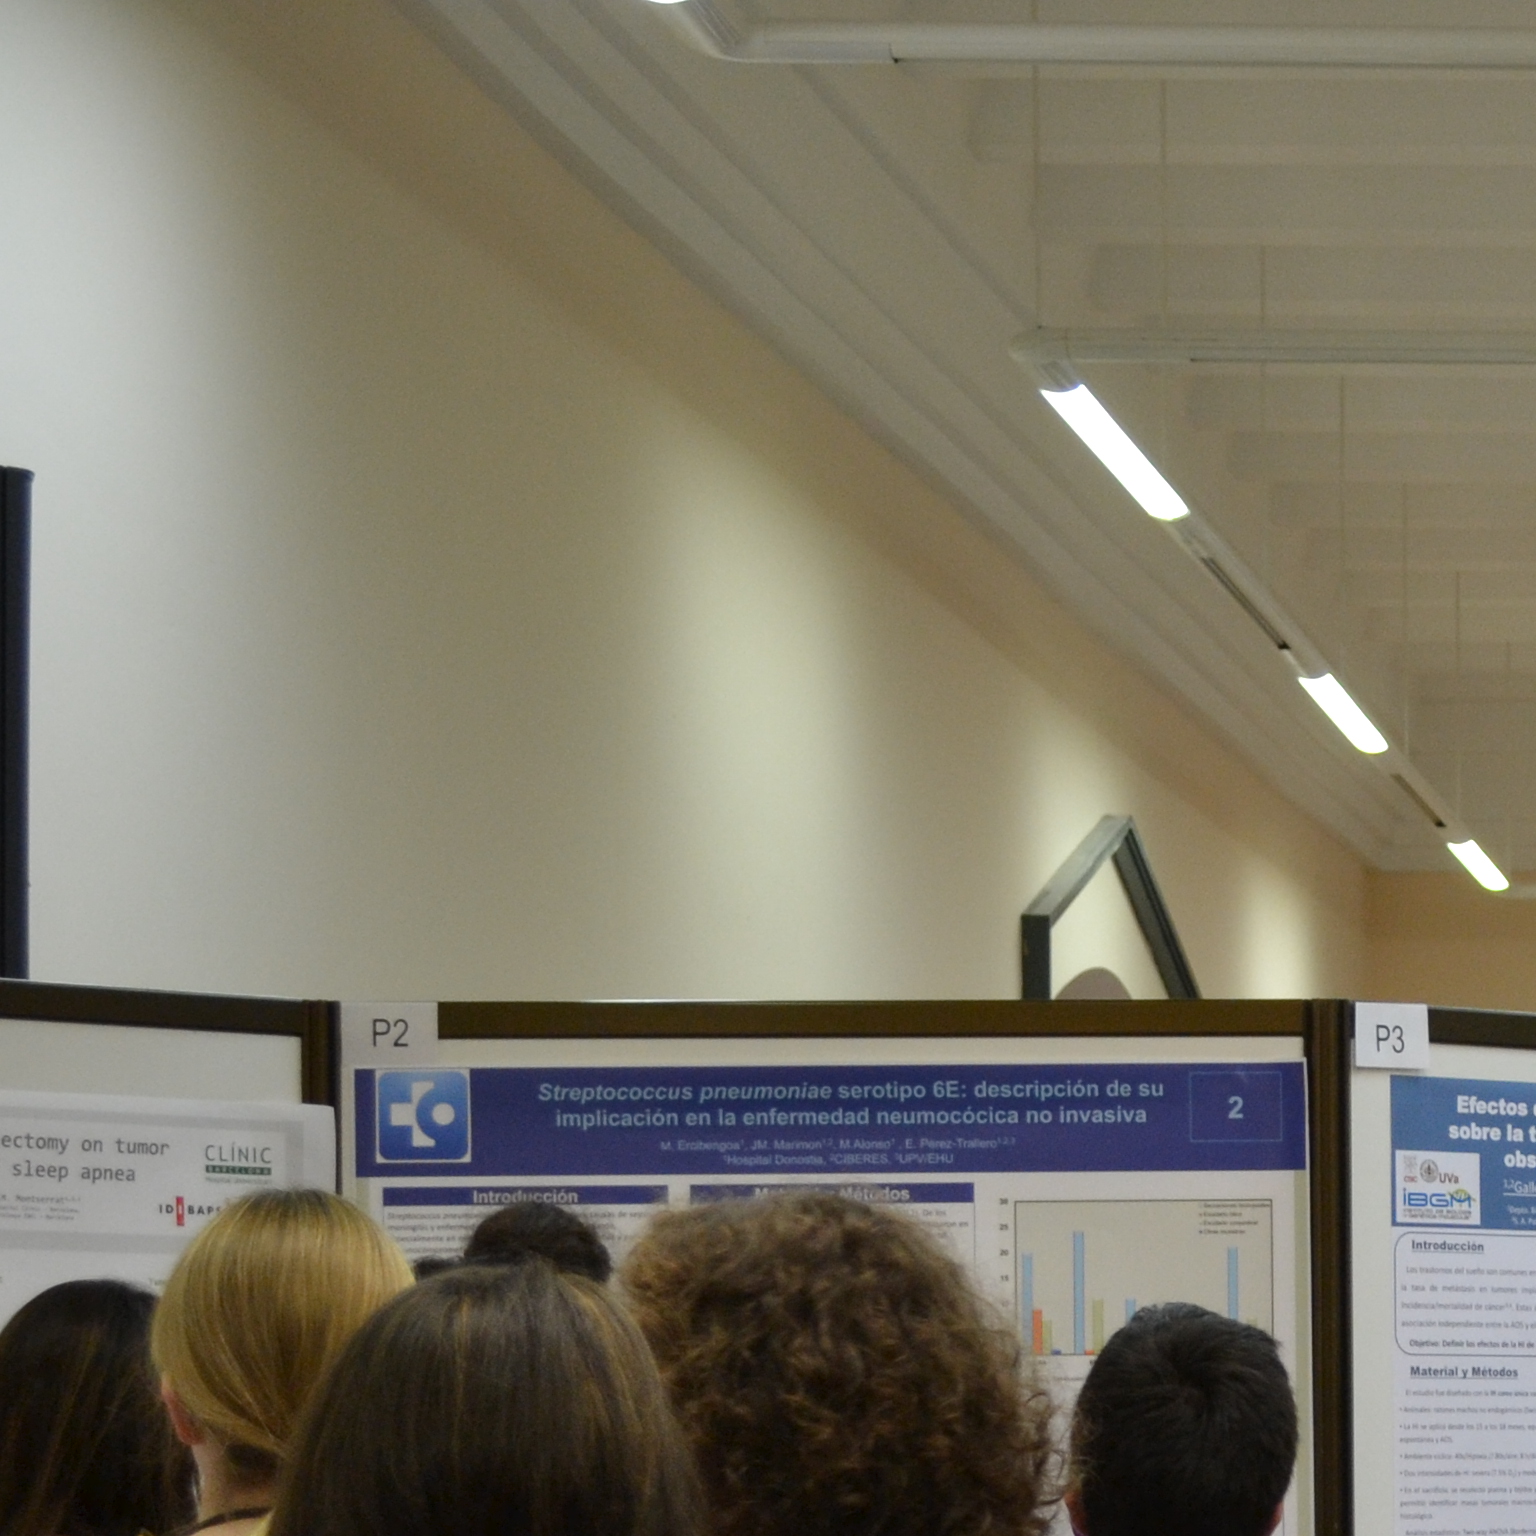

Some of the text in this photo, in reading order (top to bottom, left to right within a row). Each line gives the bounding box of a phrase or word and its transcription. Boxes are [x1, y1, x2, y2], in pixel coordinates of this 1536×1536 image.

[373, 1018, 408, 1047] P2
[1375, 1026, 1405, 1053] P3
[538, 1079, 1164, 1104] Streptococcus pneumoniae serotipo 6E: descripción de su
[556, 1104, 1147, 1130] implicación en la enfermedad neumocócica no invasiva
[1228, 1096, 1244, 1119] 2
[1457, 1095, 1528, 1117] Efectos
[1449, 1122, 1501, 1142] sobre
[1507, 1124, 1523, 1142] la
[1, 1133, 169, 1155] ectomy on tumor
[12, 1160, 136, 1184] sleep apnea
[473, 1189, 578, 1204] Introducción
[1411, 1239, 1485, 1252] Introducción
[1410, 1365, 1519, 1382] Material y Métodos
